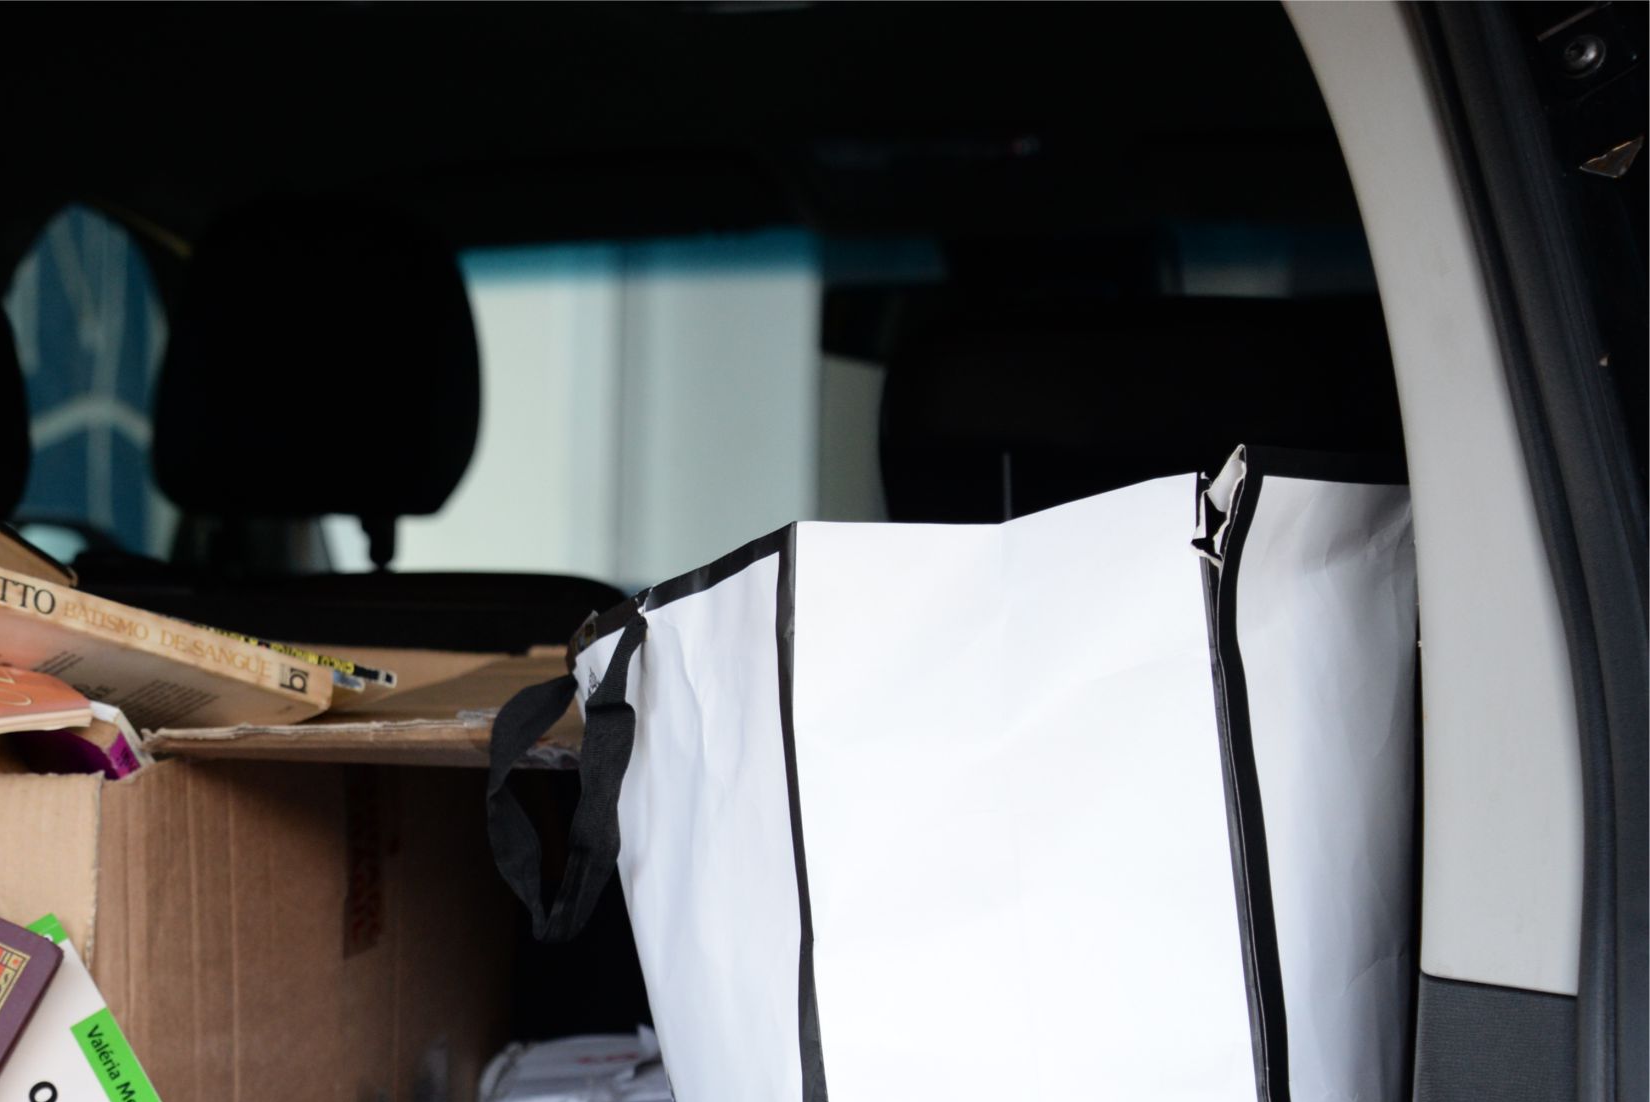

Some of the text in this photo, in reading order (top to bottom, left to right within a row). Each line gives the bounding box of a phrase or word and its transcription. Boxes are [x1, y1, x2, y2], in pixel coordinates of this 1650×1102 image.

[62, 601, 150, 642] BATISMO
[161, 628, 188, 652] DE
[192, 638, 275, 681] SANGUE
[86, 1023, 121, 1081] Valéria
